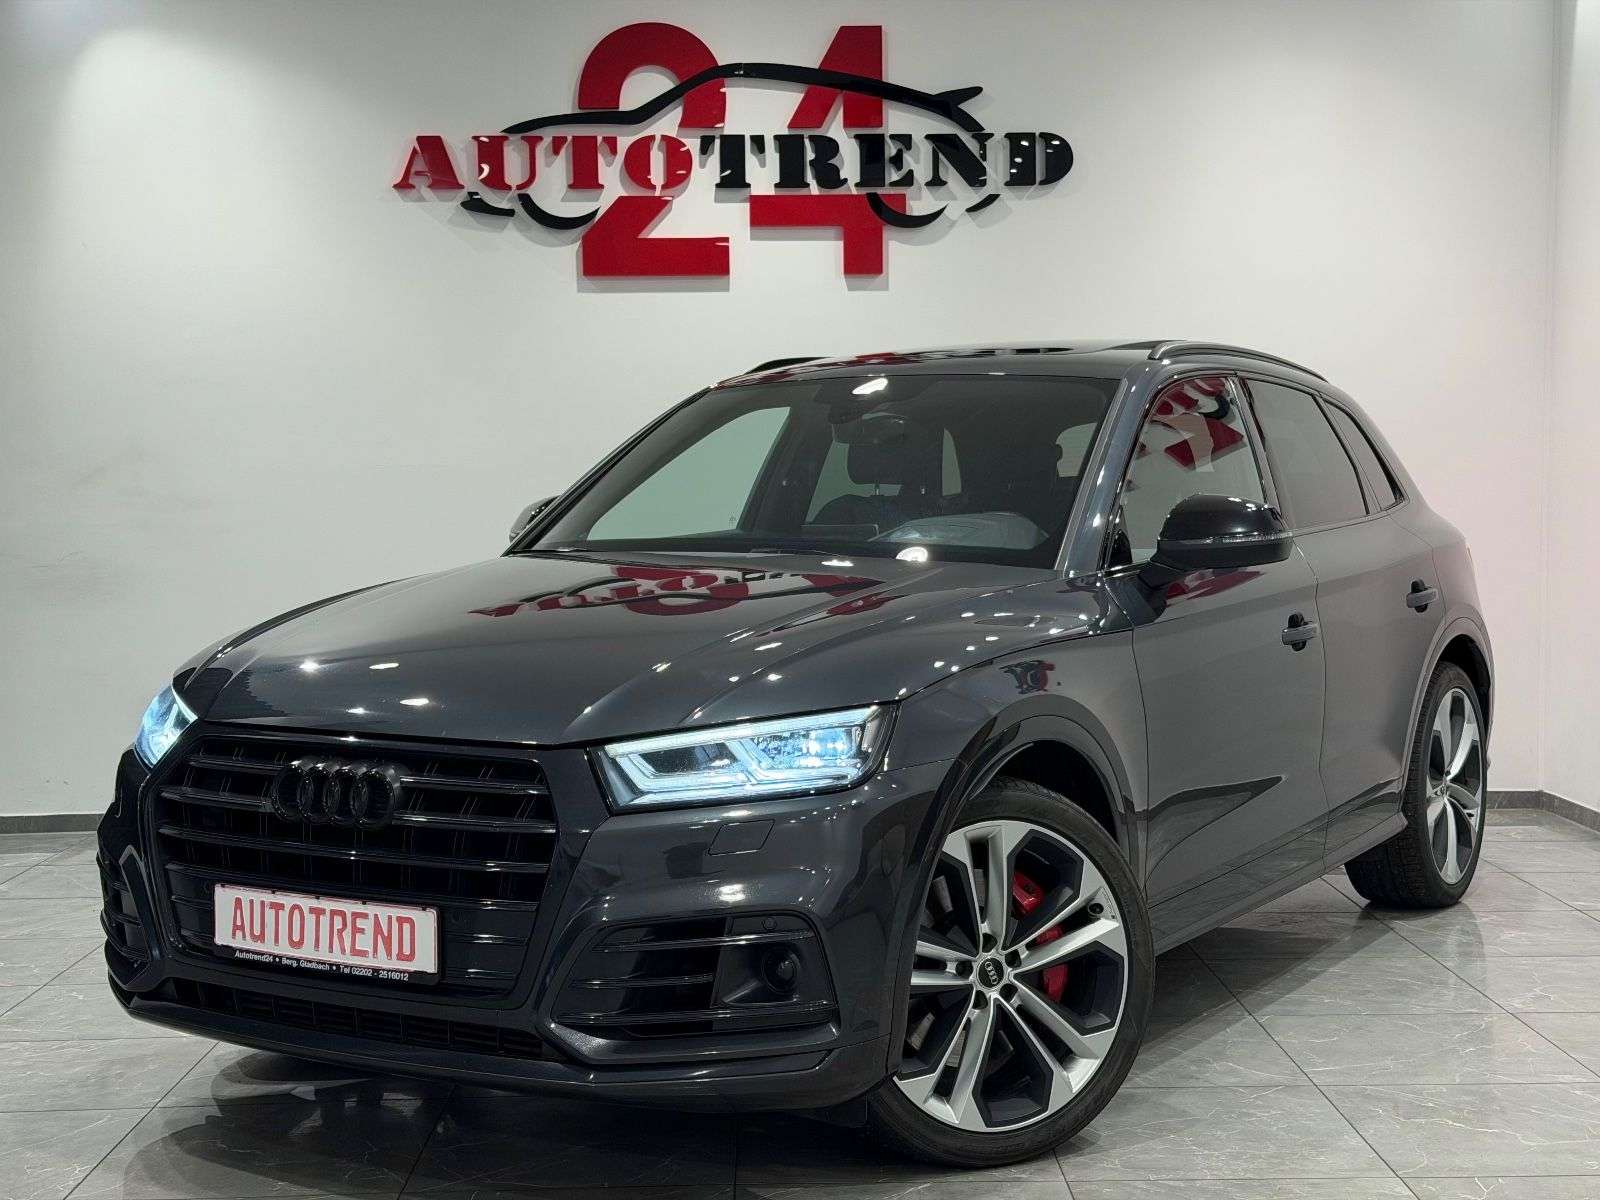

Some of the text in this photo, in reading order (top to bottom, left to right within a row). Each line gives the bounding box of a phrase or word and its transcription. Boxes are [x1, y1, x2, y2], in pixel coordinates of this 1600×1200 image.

[392, 133, 1074, 191] AUTOTREND
[578, 22, 907, 277] 24
[231, 896, 416, 962] AUTOTREND
[234, 950, 274, 963] Autotrend24
[299, 960, 330, 971] Gladbach
[351, 967, 373, 977] 02202
[378, 970, 409, 981] 2516012
